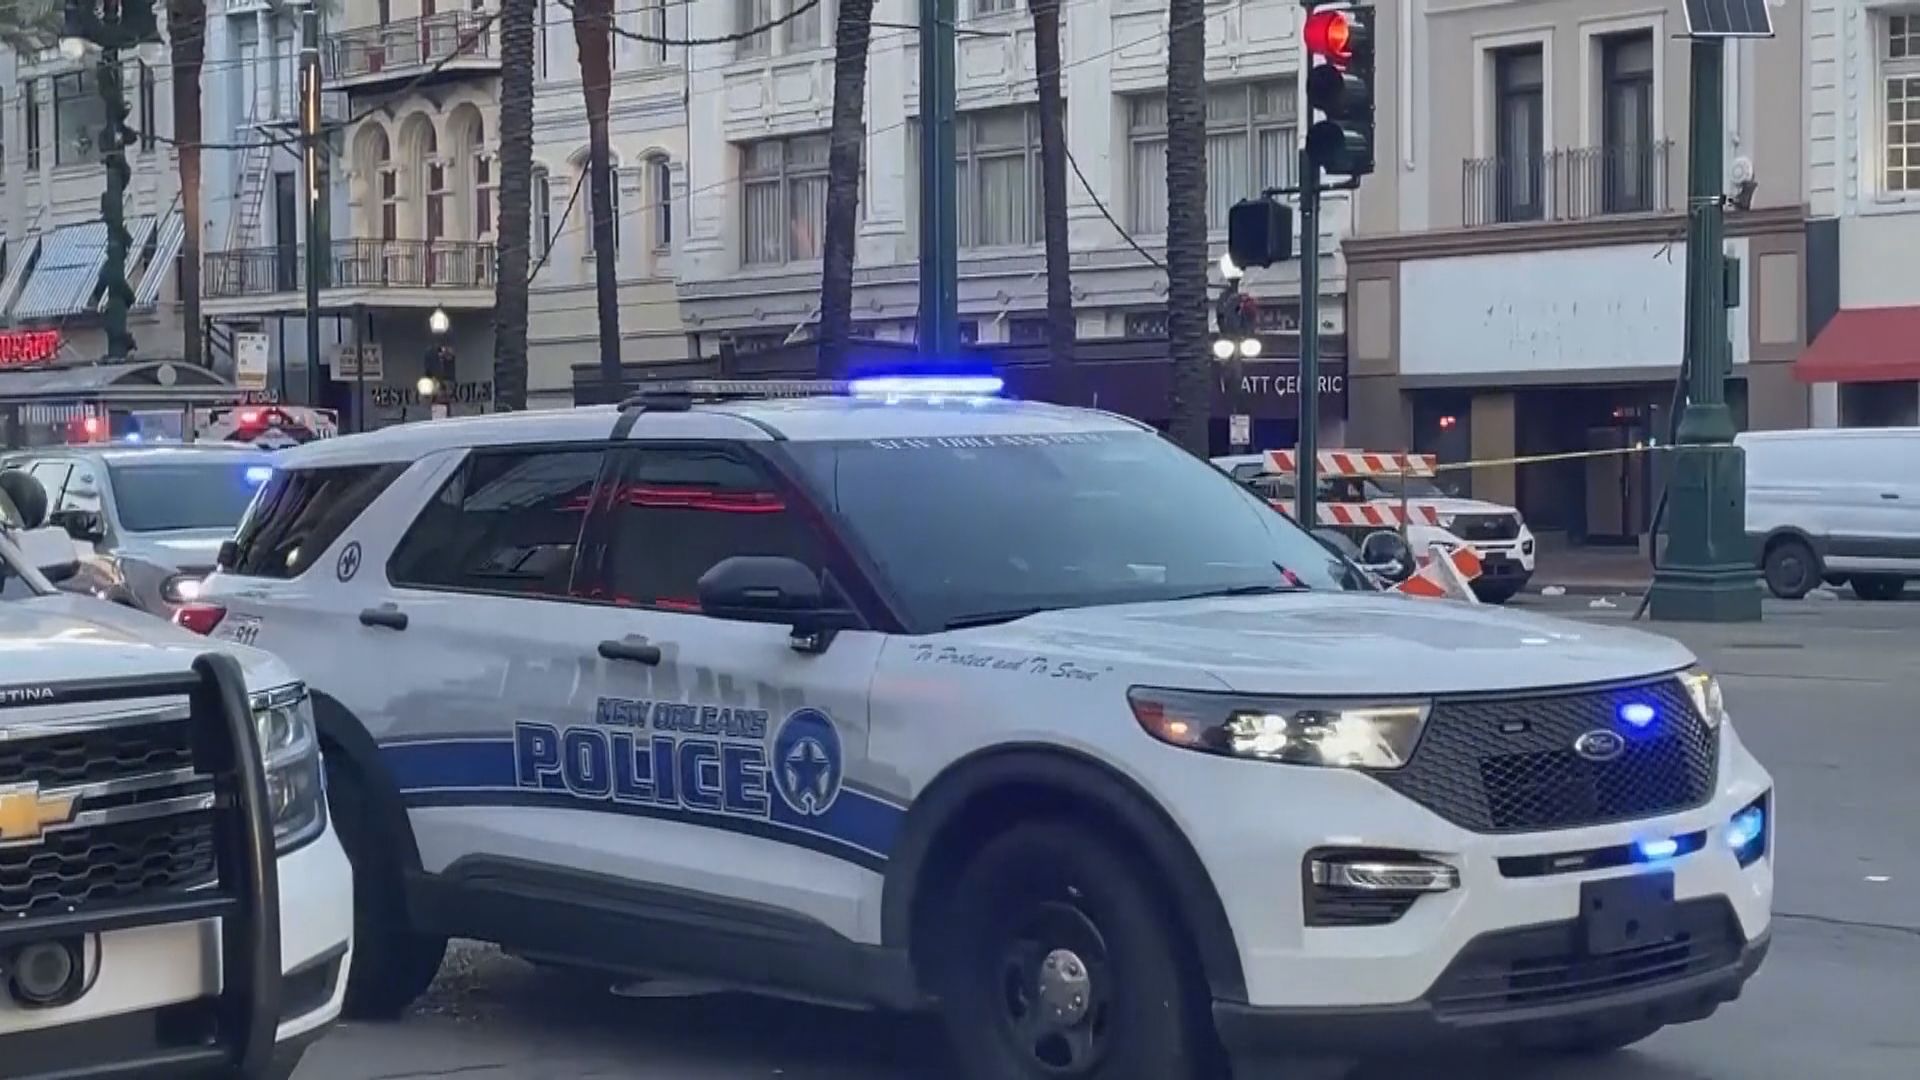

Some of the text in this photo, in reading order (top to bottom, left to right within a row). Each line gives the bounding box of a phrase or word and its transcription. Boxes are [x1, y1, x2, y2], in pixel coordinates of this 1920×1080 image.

[1274, 375, 1343, 395] CERIC
[597, 696, 768, 739] NEW ORLEANS
[513, 720, 771, 817] POLICE
